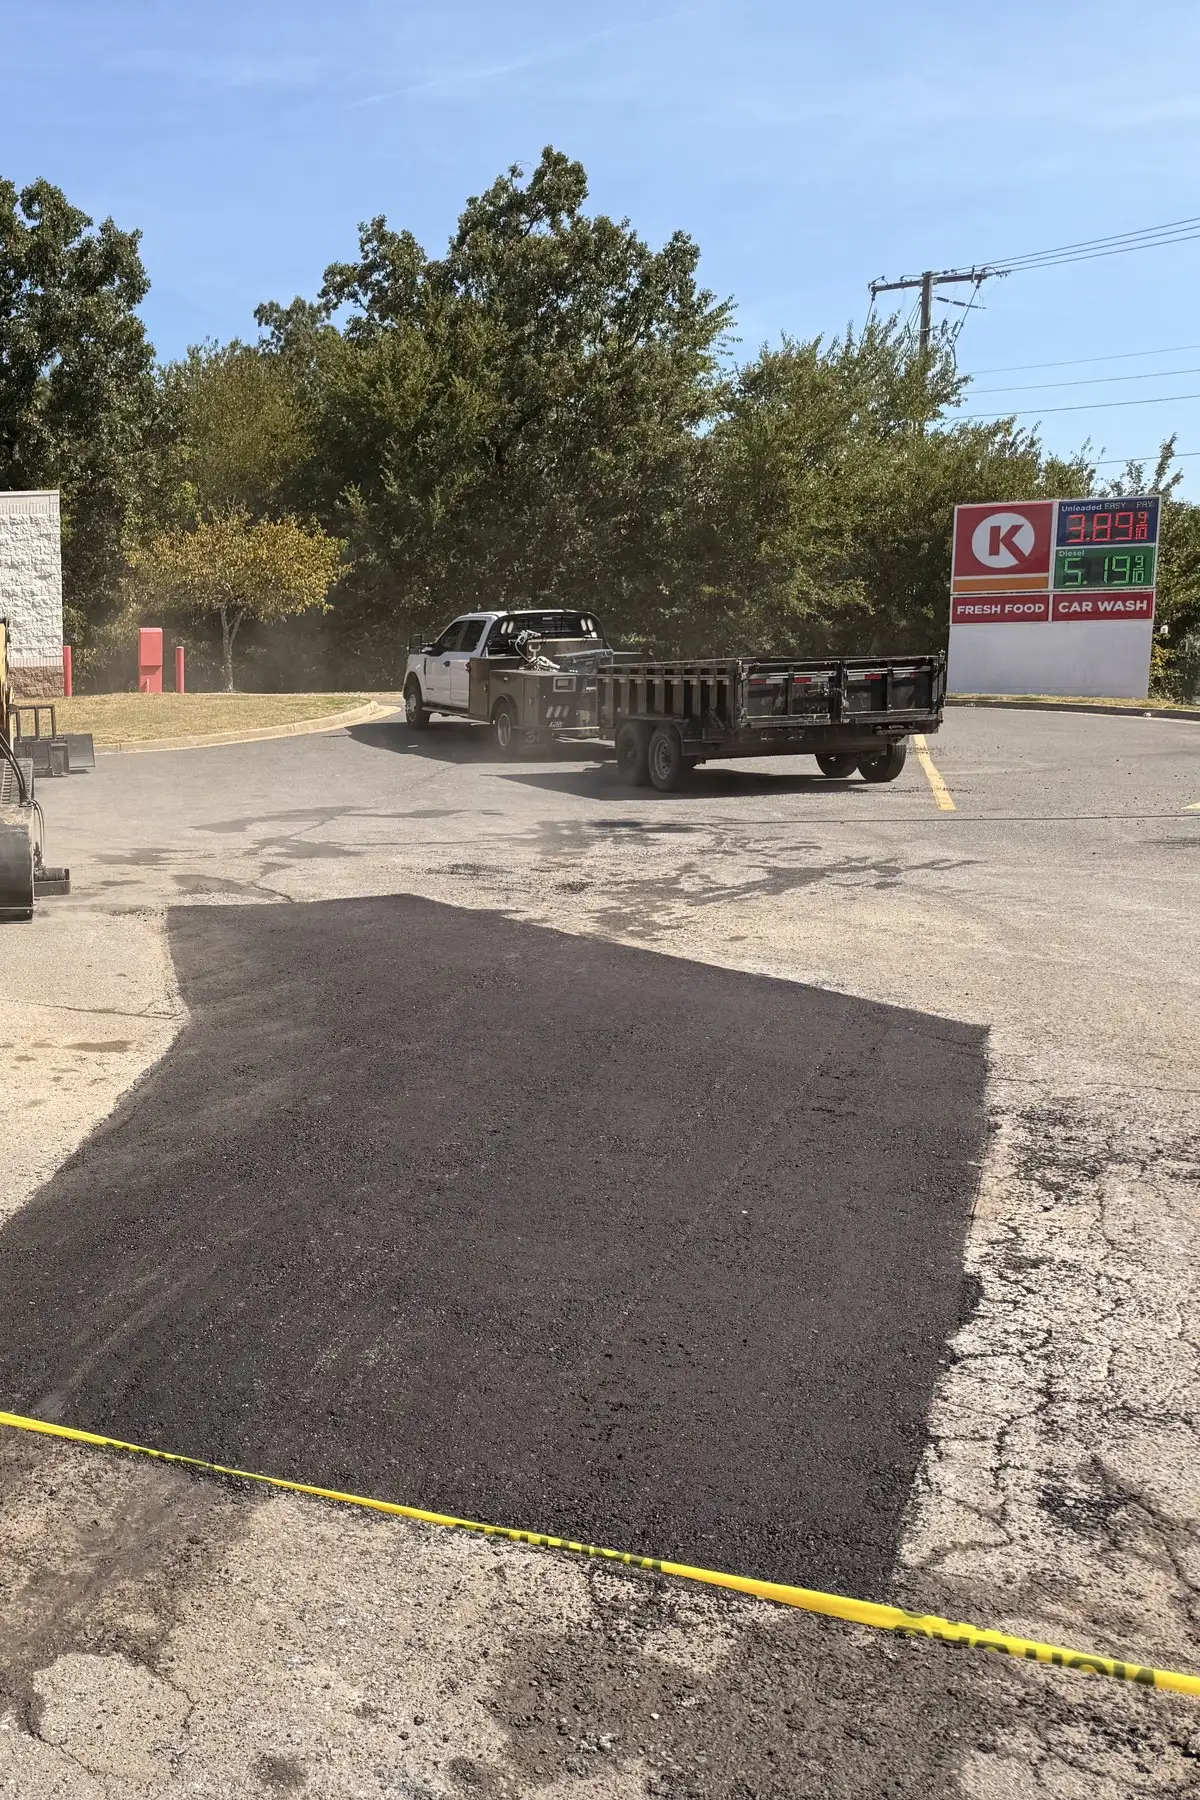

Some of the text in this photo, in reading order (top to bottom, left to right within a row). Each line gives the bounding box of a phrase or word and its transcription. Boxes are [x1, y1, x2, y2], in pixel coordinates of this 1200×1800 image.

[1061, 503, 1102, 513] Unleaded
[1066, 511, 1134, 543] 3.89
[987, 523, 1029, 565] K
[1058, 550, 1085, 558] Diesel
[1063, 555, 1131, 586] 5.19
[956, 603, 1045, 615] FRESH FOOD
[1058, 600, 1148, 613] CAR WASH
